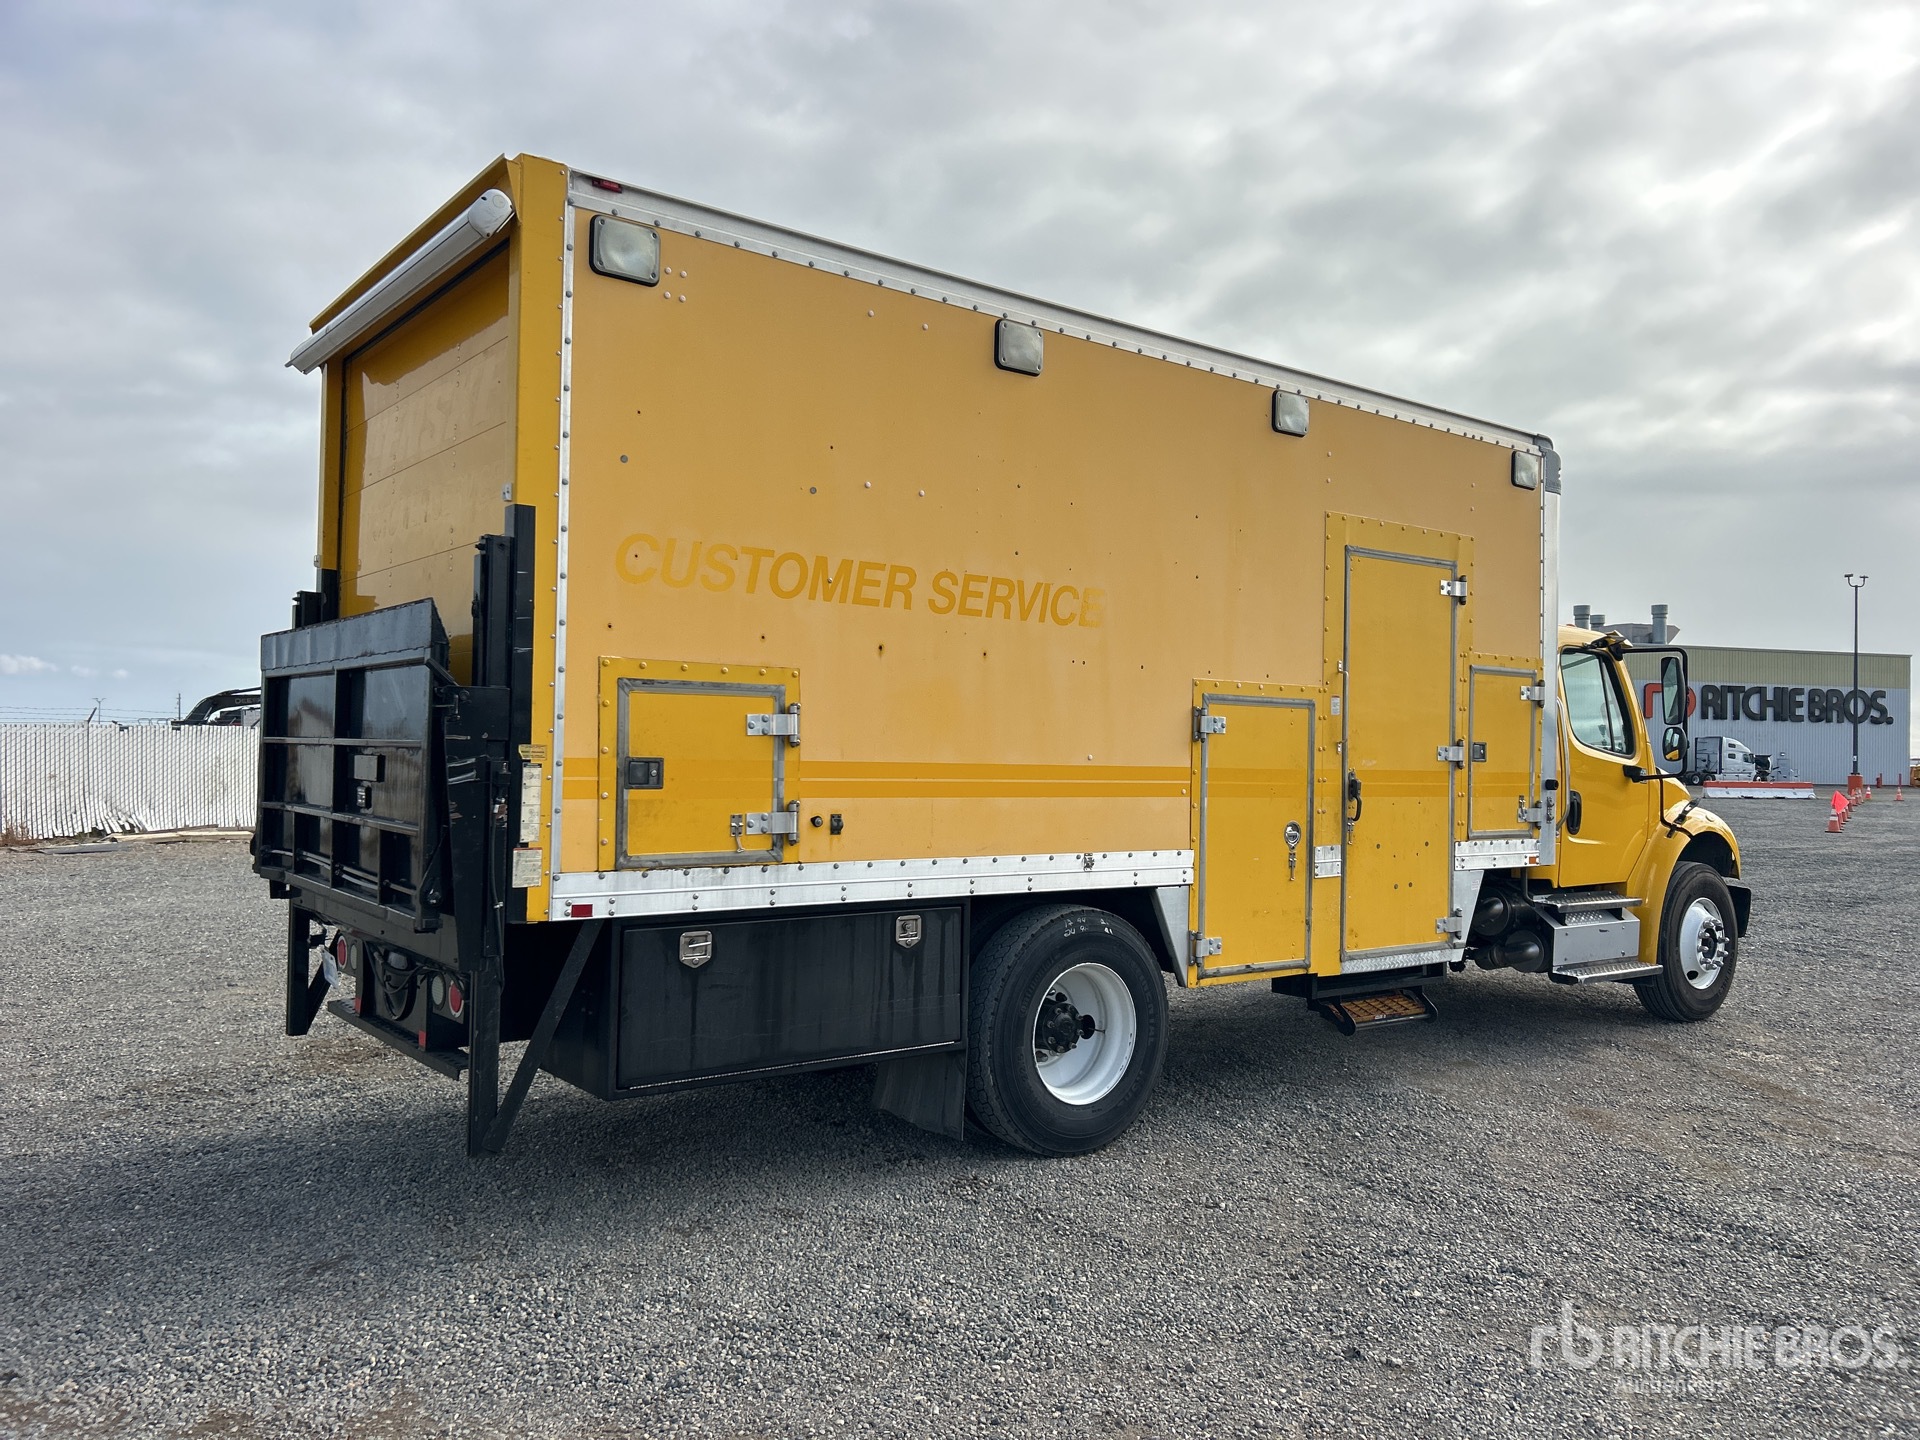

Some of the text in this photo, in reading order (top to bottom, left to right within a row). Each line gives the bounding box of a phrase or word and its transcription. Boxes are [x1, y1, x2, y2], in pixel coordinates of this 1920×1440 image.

[615, 533, 1106, 628] CUSTOMER SERVICE
[1701, 685, 1804, 723] RITCHIE
[1808, 688, 1894, 724] BROS.
